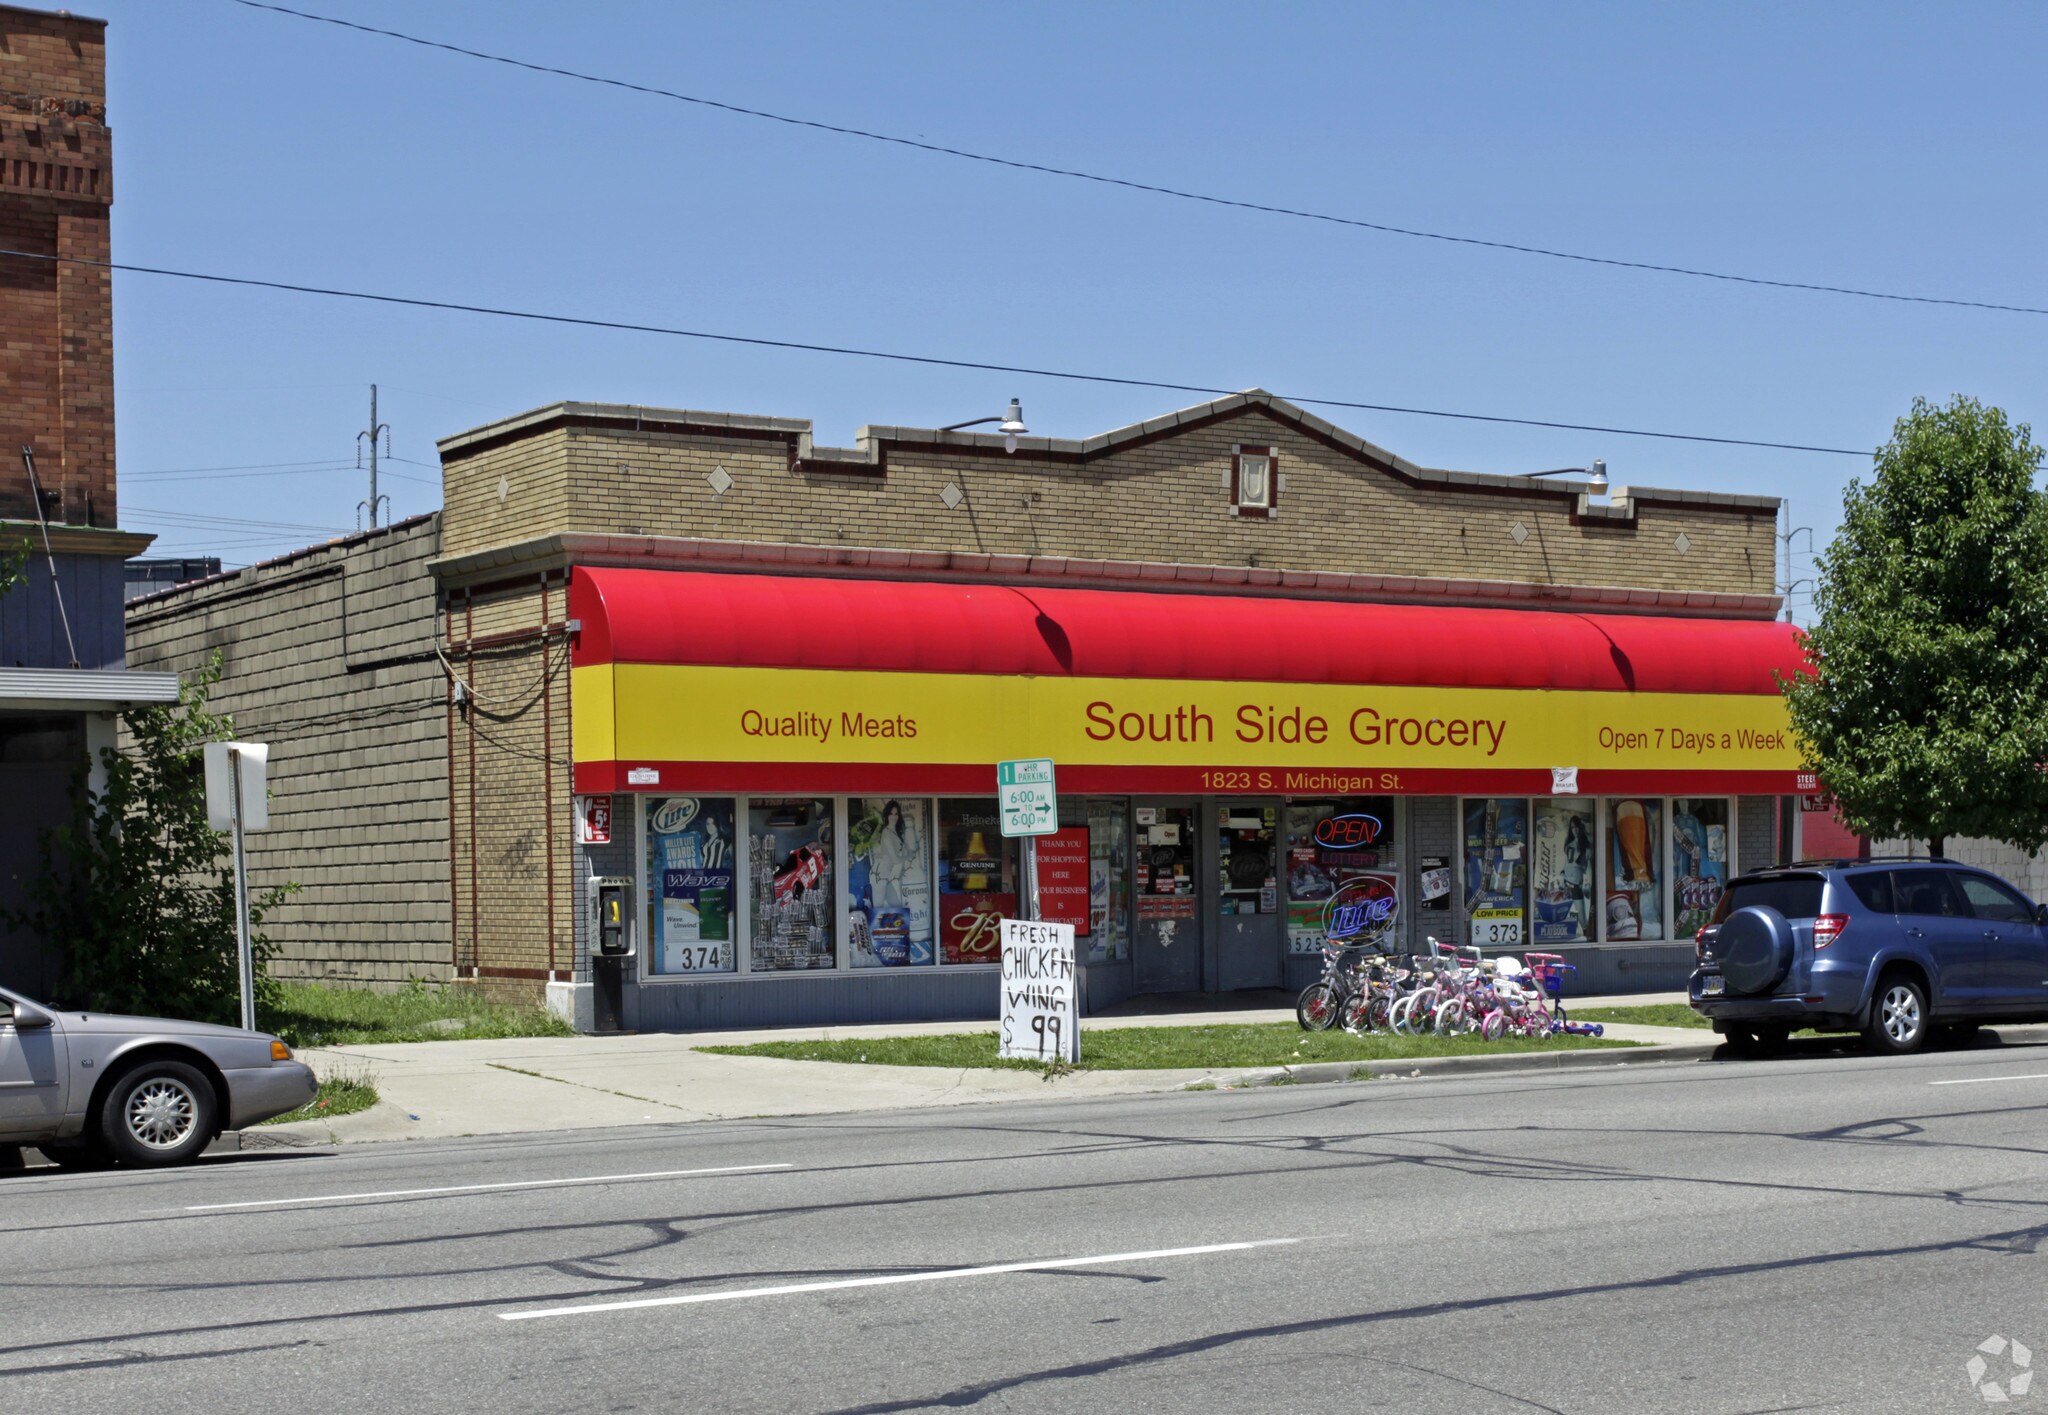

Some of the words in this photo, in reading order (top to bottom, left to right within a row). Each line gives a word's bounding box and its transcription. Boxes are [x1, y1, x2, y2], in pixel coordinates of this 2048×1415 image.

[741, 710, 832, 743] Quality
[841, 712, 917, 738] Meats
[1084, 701, 1213, 743] South
[1235, 704, 1329, 743] Side
[1349, 707, 1506, 756] Grocery
[1599, 726, 1648, 753] Open
[1653, 728, 1664, 748] 7
[1671, 728, 1716, 754] Days
[1721, 733, 1731, 749] a
[1736, 729, 1785, 749] Week
[1003, 765, 1010, 782] 1
[1027, 763, 1038, 772] HR
[1018, 772, 1048, 781] PARKING
[1200, 772, 1251, 789] 1823
[1257, 772, 1278, 789] S.
[1285, 772, 1373, 793] Michigan
[1379, 774, 1404, 790] St.
[1010, 791, 1034, 803] 6:00
[664, 805, 692, 829] Lite
[962, 814, 1001, 825] Heineke
[1011, 814, 1036, 826] 6:00
[1316, 818, 1377, 844] OPEN
[667, 846, 696, 860] AWARDS
[1321, 852, 1377, 866] LOTTERY
[959, 861, 996, 869] GENUINE
[667, 874, 730, 887] Wave
[1327, 896, 1394, 939] Lite
[1476, 910, 1493, 918] LOW
[1495, 909, 1519, 917] PRICE
[1010, 924, 1058, 944] FRESH
[682, 947, 719, 970] 3.74
[1001, 946, 1073, 981] CHICKEN
[1008, 984, 1066, 1012] WING
[1003, 1012, 1015, 1050] $
[1031, 1015, 1061, 1058] 99
